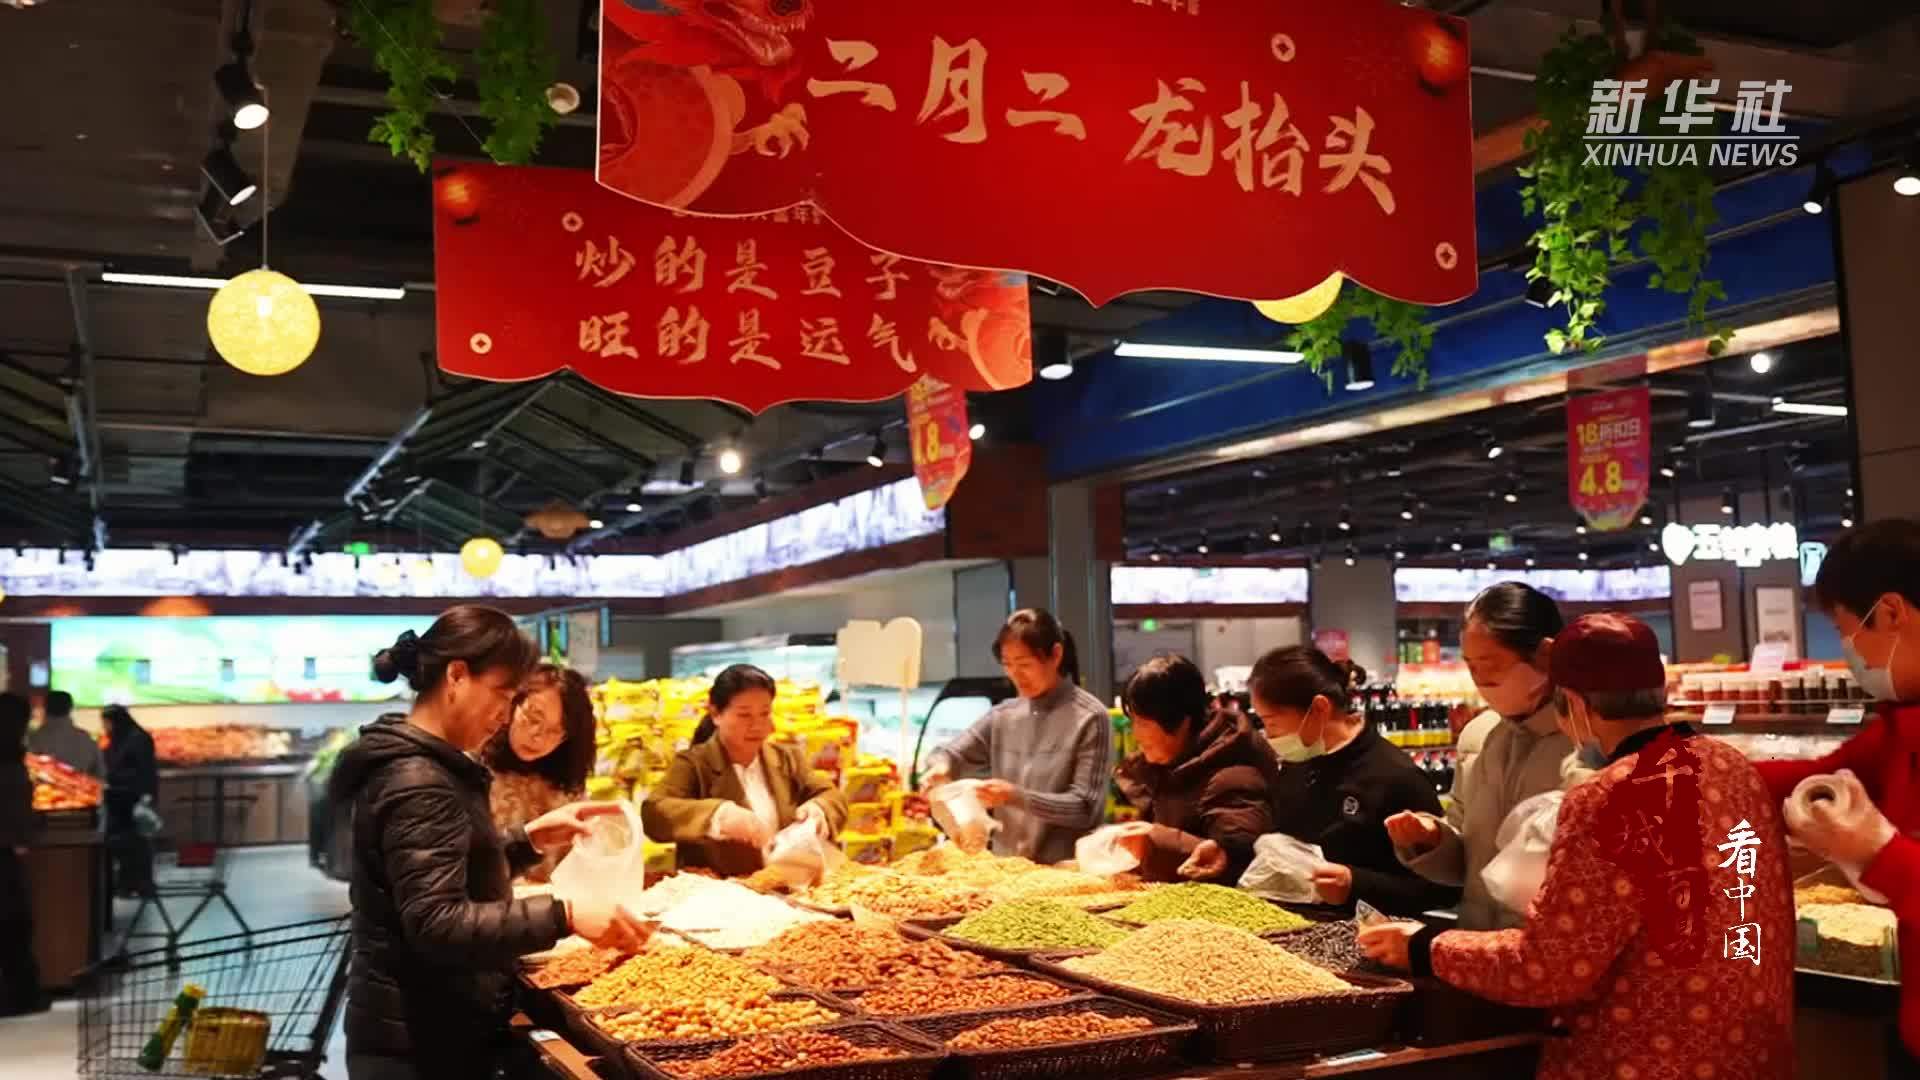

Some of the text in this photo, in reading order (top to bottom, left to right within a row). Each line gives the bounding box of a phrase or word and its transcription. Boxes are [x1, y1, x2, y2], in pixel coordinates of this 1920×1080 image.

[806, 36, 1396, 215] 二月二 龙抬头
[574, 234, 910, 300] 炒的是豆子
[578, 305, 917, 373] 旺的是运气
[1579, 461, 1623, 496] 4.8
